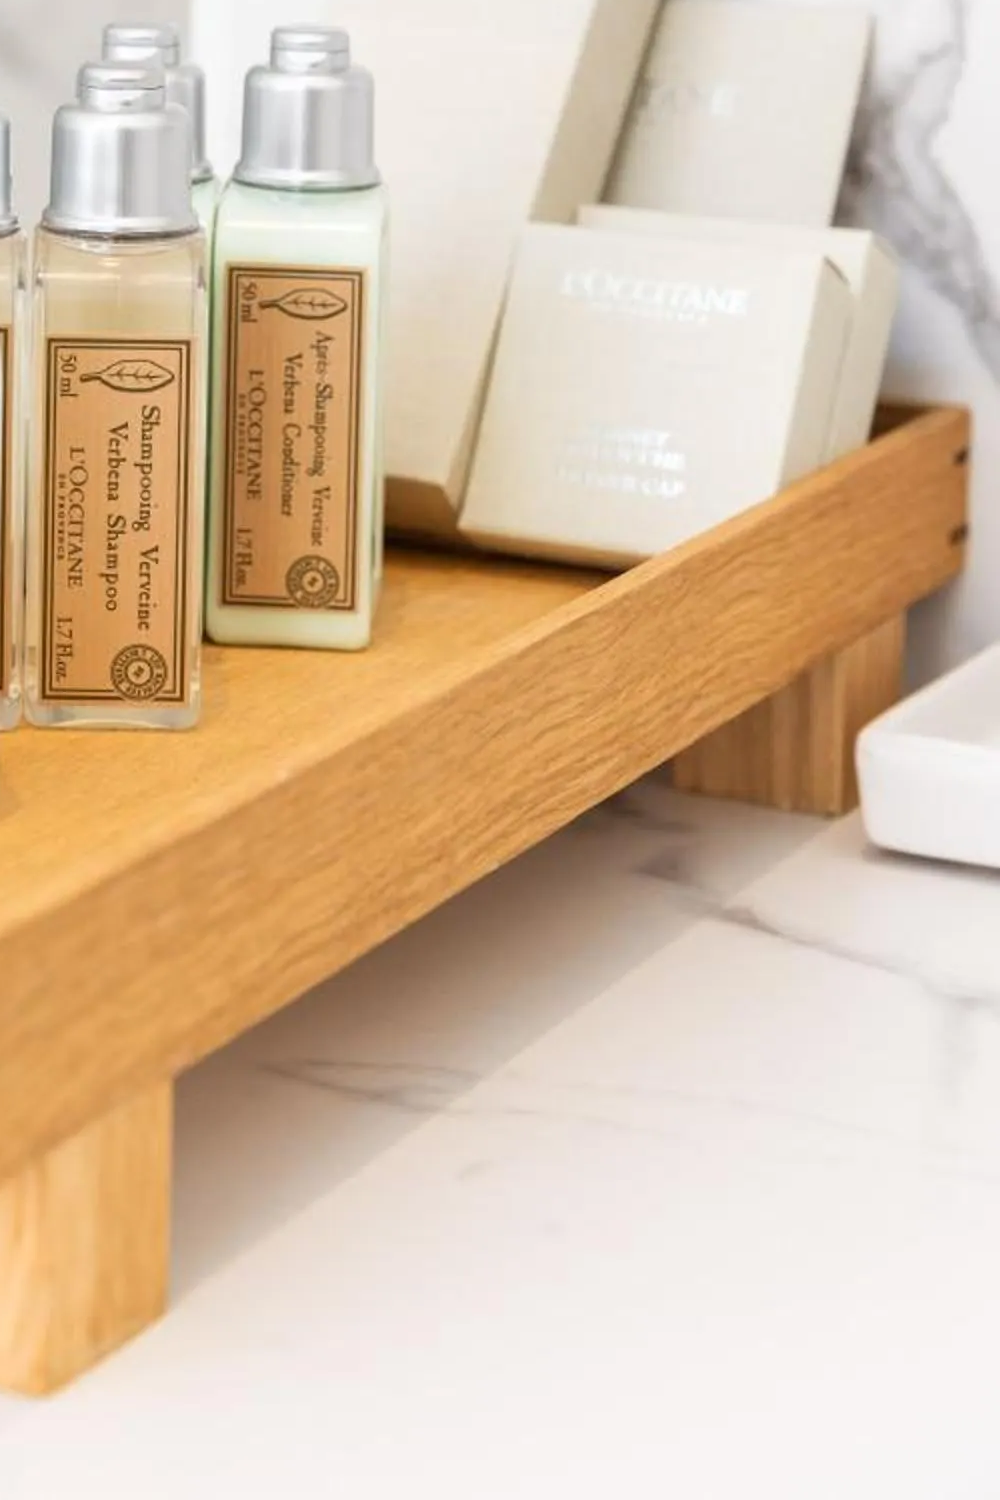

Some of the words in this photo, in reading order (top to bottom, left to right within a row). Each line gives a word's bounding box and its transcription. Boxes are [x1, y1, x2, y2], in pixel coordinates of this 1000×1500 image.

[240, 281, 258, 300] 50
[240, 304, 258, 323] ml
[59, 353, 78, 375] 50
[59, 378, 78, 399] ml
[283, 353, 303, 414] Verbena
[105, 421, 129, 502] Verbena
[132, 404, 161, 532] Shampooing
[247, 369, 268, 501] L'OCCITANE
[281, 422, 302, 518] Conditioner
[67, 446, 90, 589] L'OCCITANE
[311, 485, 332, 547] Verveine
[98, 514, 127, 613] Shampoo
[137, 545, 160, 632] Verveine
[55, 616, 74, 638] 1.7
